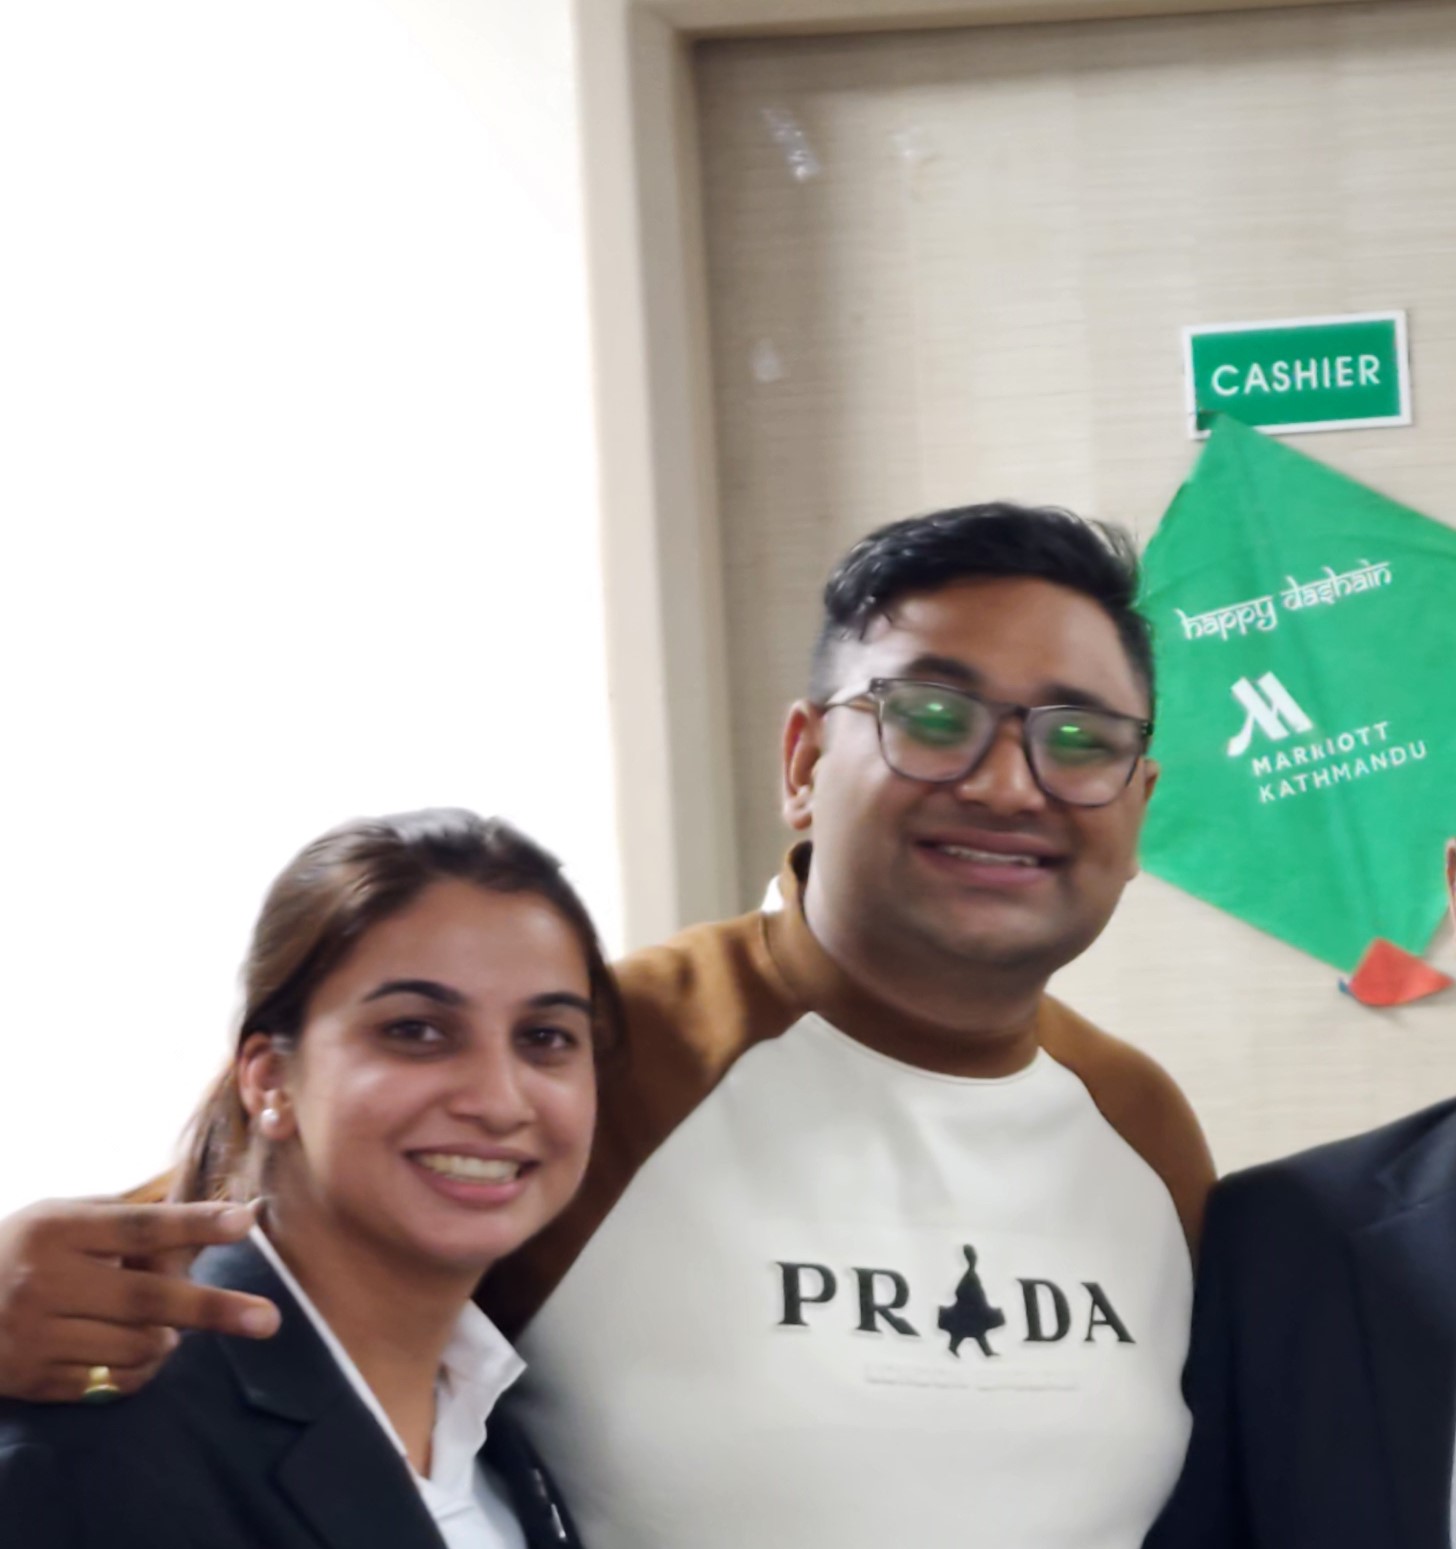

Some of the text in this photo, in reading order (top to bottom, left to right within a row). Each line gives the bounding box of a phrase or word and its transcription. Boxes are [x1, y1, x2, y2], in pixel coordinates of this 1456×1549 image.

[1211, 354, 1381, 397] CASHIER
[1174, 558, 1392, 641] happy dashain
[1252, 721, 1389, 777] MARRIOTT
[1259, 740, 1428, 804] KATHMANDU
[775, 1243, 1137, 1359] PRADA
